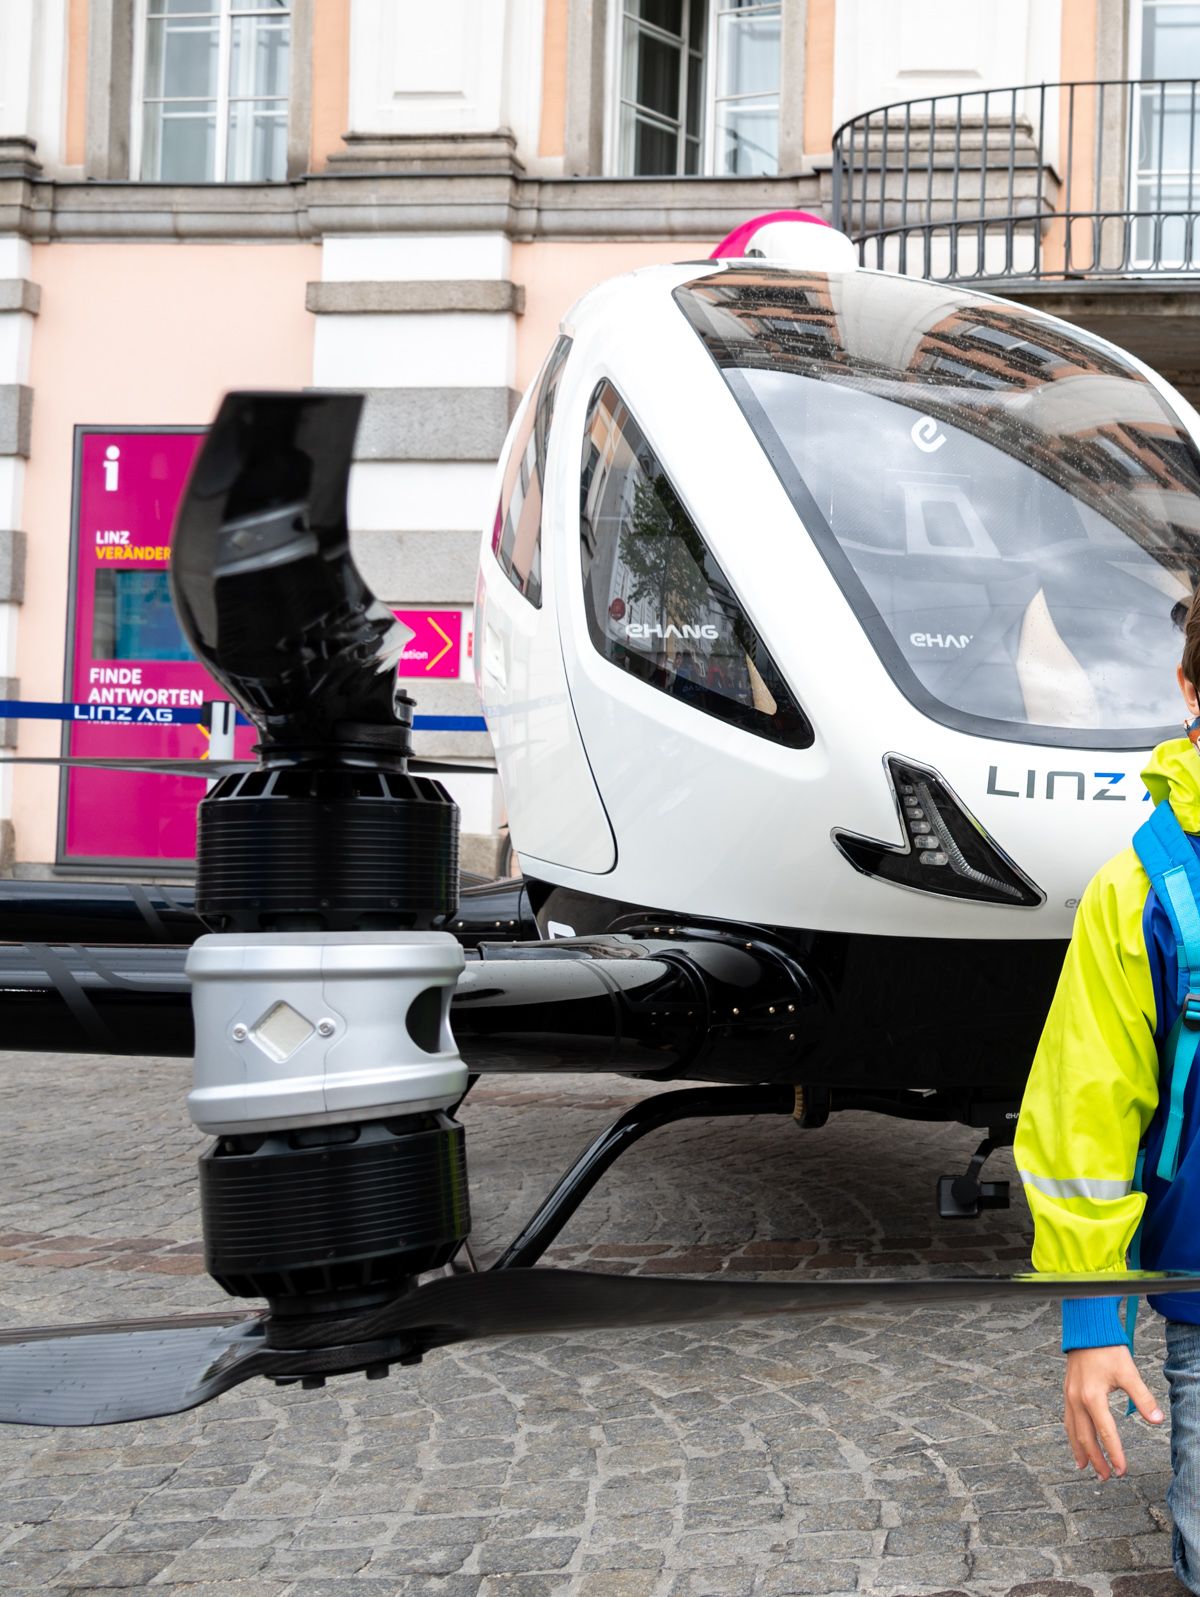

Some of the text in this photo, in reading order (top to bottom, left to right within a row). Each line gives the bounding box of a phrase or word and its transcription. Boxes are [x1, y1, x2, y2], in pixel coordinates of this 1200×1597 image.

[95, 530, 130, 545] LINZ
[95, 544, 171, 560] VERÄNDER
[89, 667, 142, 685] FINDE
[87, 687, 203, 705] ANTWORTEN
[74, 705, 173, 722] LINZ AG
[987, 765, 1126, 801] LINZ
